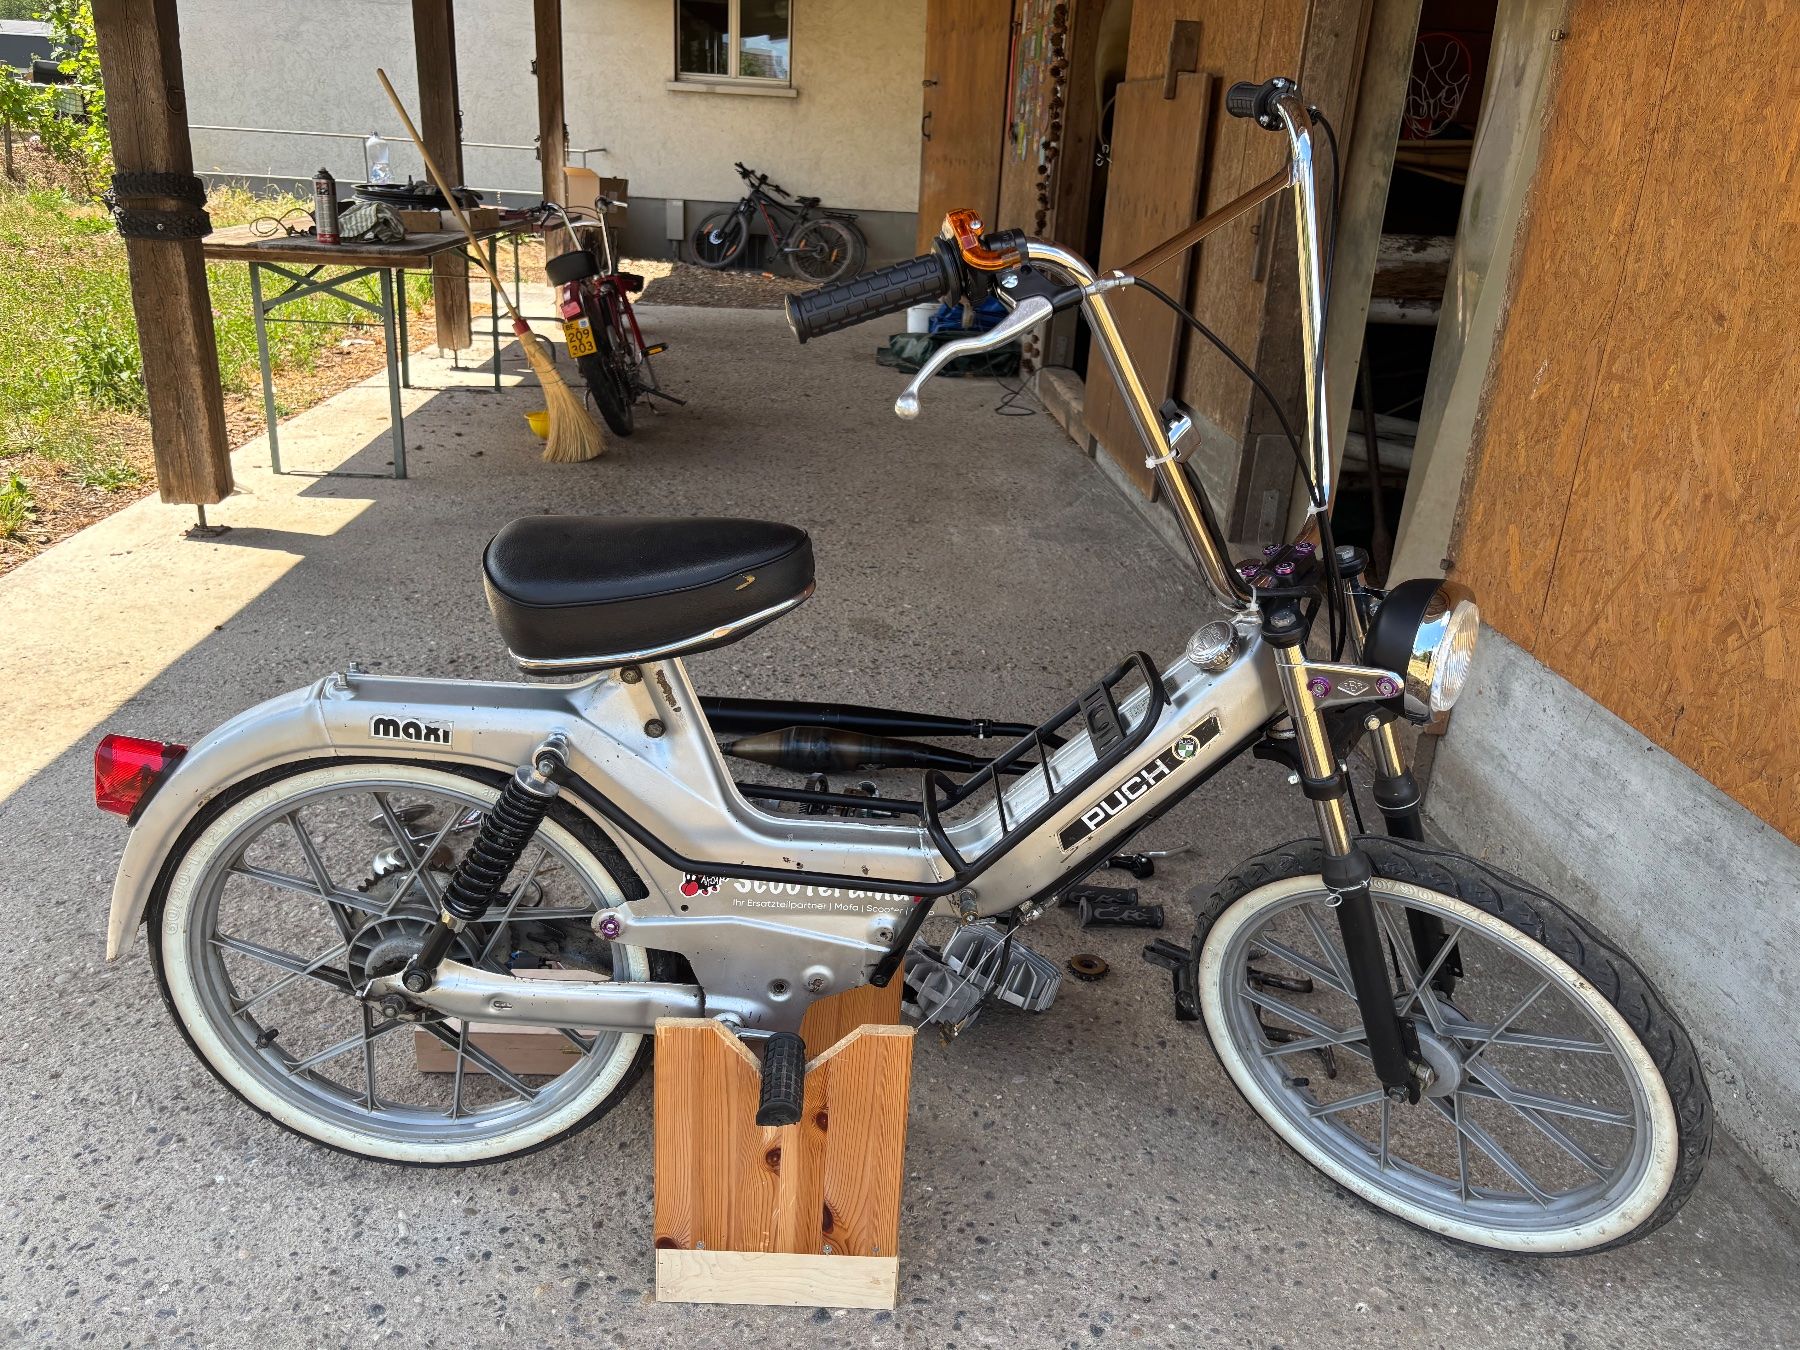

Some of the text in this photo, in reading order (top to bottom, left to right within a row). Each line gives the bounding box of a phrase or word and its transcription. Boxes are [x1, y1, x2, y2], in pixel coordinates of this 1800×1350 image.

[568, 329, 590, 343] 209
[1080, 758, 1171, 831] PUCH
[732, 898, 745, 907] Ihr
[747, 899, 826, 910] Ersatzteilpartner
[834, 902, 859, 912] Mofa
